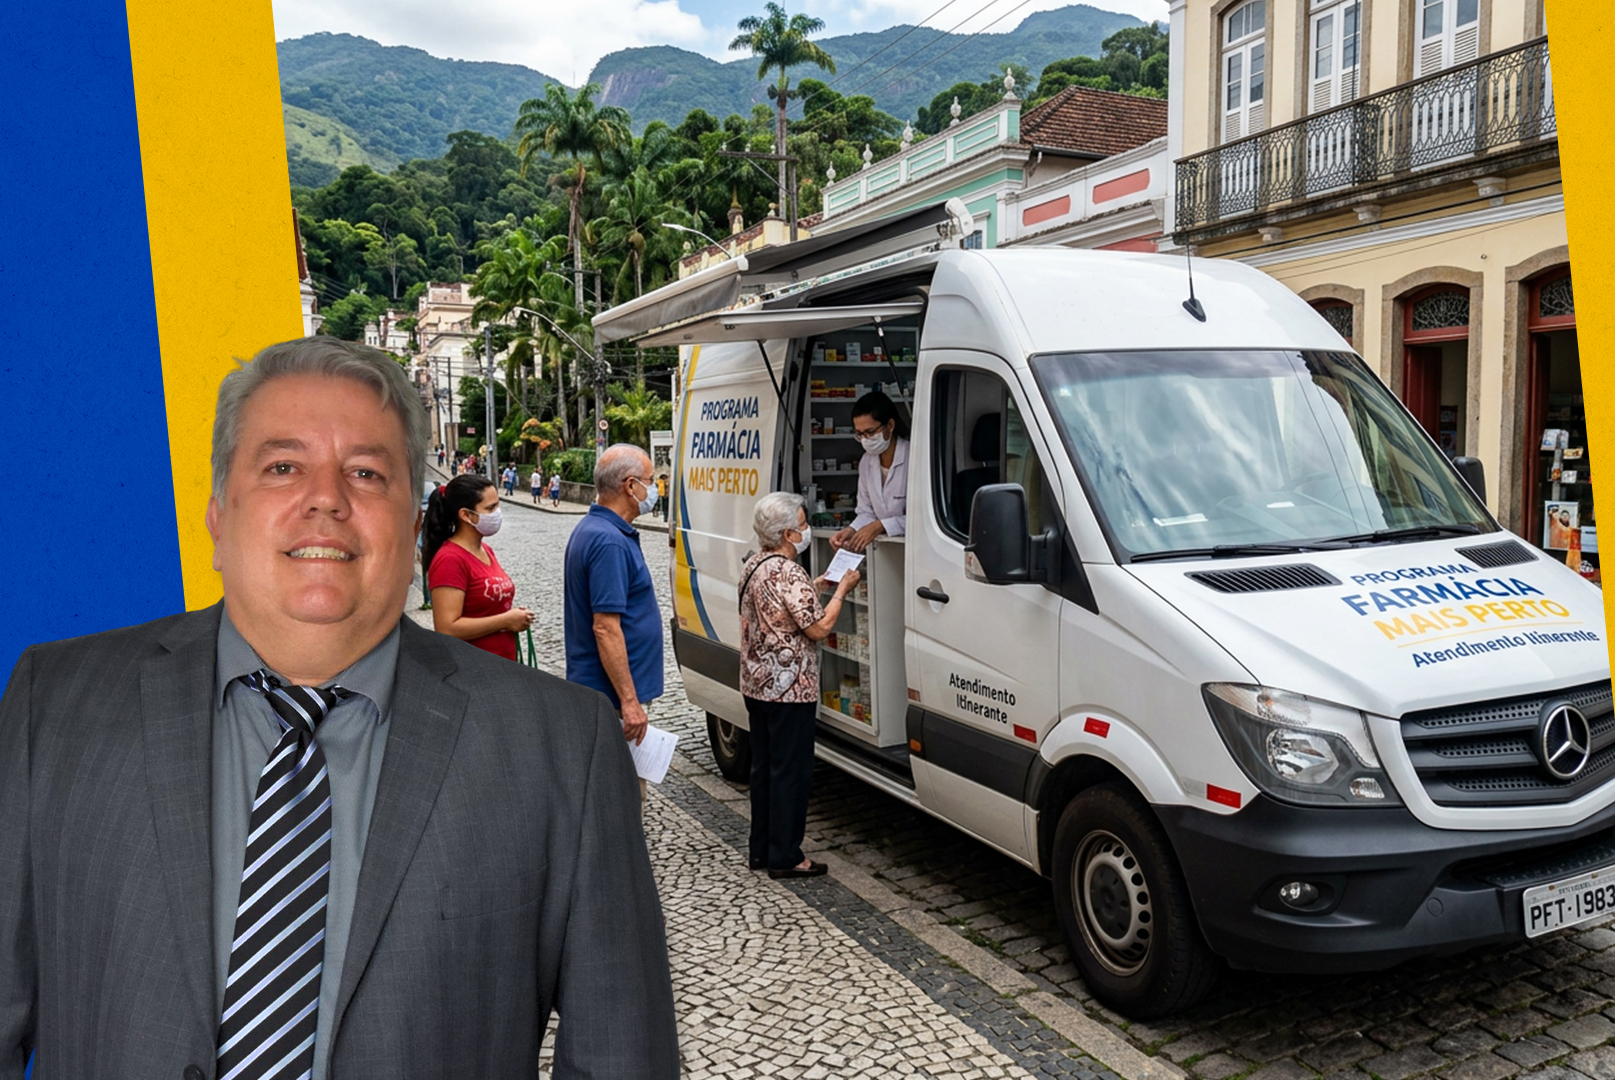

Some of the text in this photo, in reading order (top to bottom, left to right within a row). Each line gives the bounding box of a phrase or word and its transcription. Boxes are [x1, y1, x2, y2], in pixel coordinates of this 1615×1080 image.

[700, 396, 759, 421] PROGRAMA
[691, 421, 761, 460] FARMÁCIA
[688, 466, 759, 496] MAIS PERTO
[1350, 563, 1479, 586] PROGRAMA
[1340, 575, 1545, 616] FARMÁCIA
[1373, 599, 1570, 641] MAIS PERTO
[1412, 635, 1526, 668] Atendimento
[949, 672, 1016, 707] Atendimento
